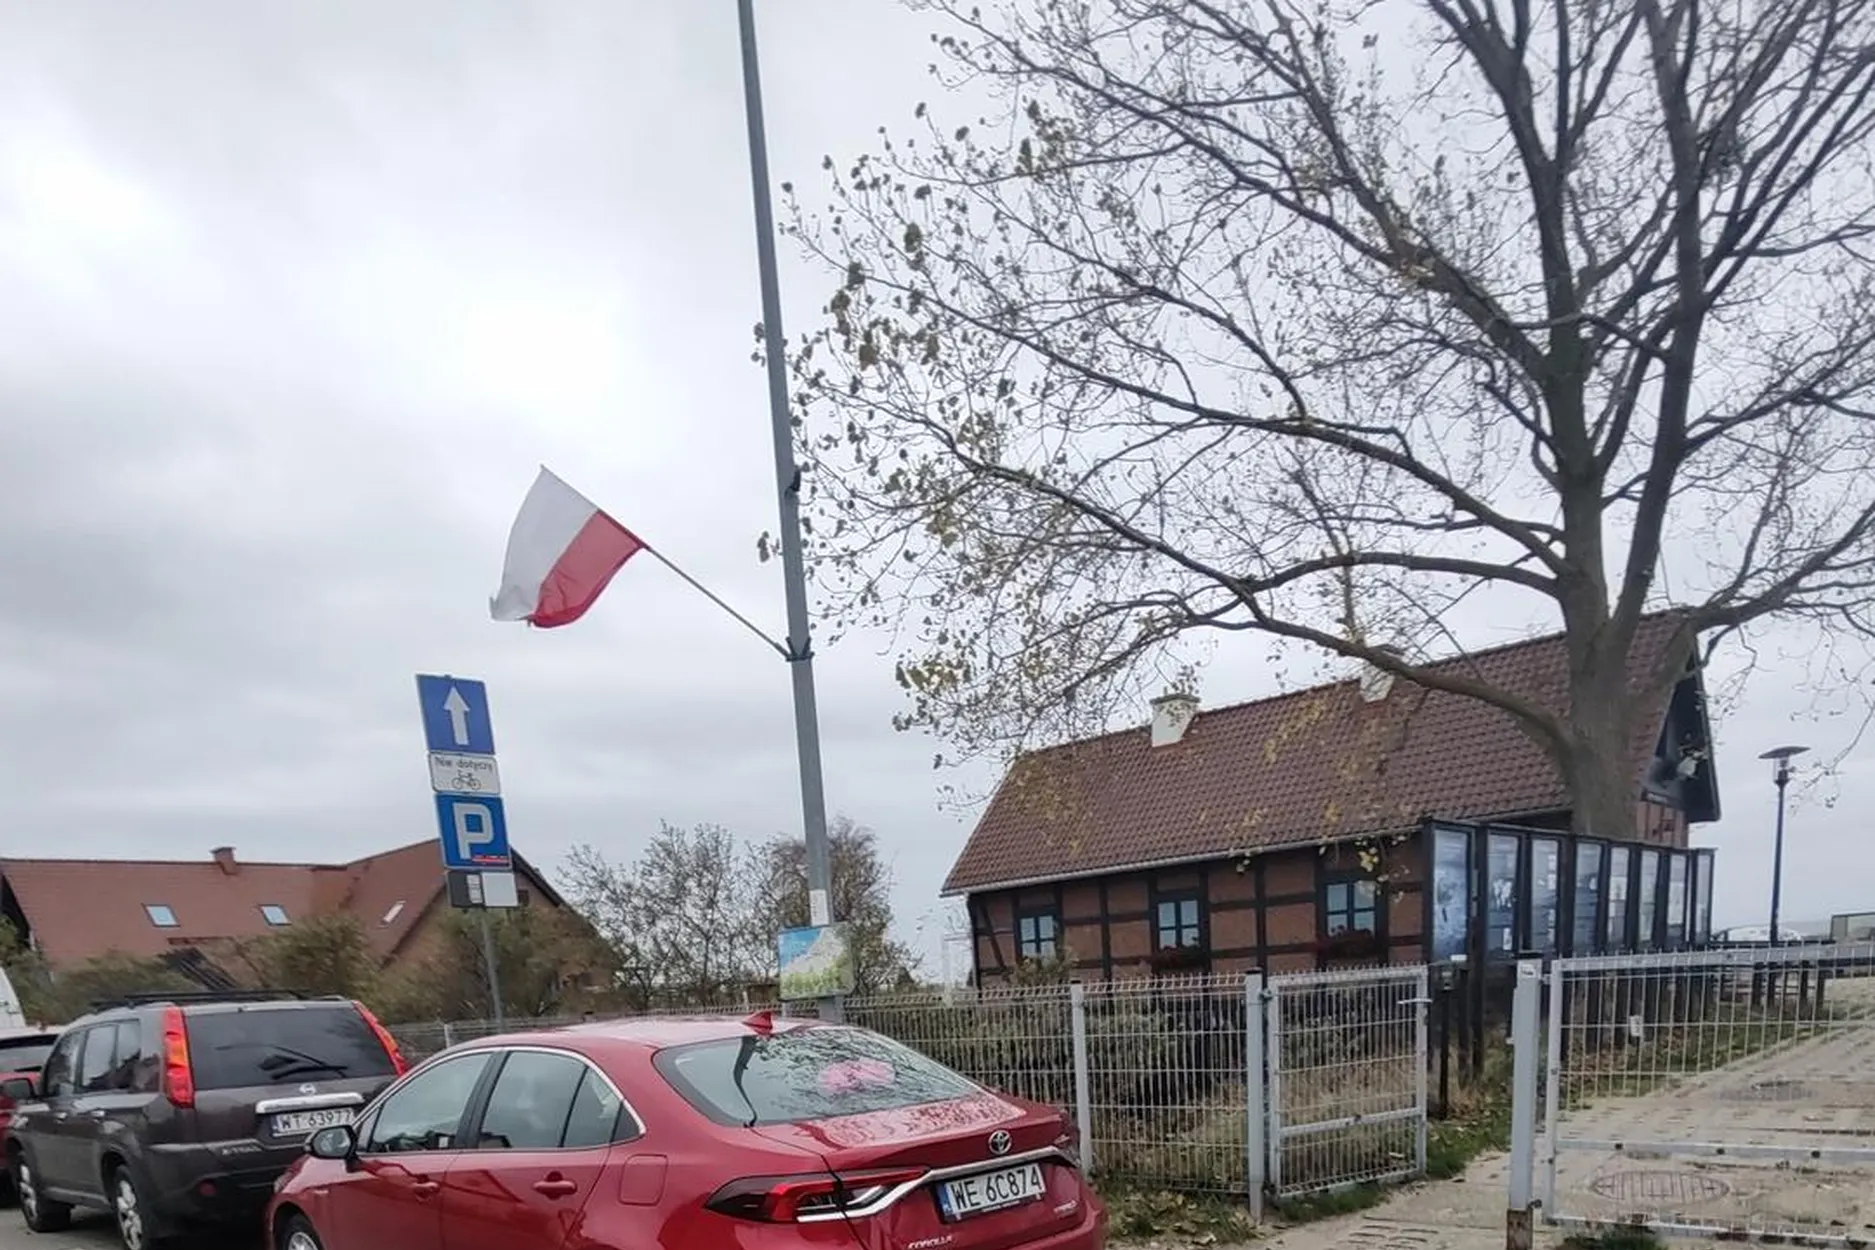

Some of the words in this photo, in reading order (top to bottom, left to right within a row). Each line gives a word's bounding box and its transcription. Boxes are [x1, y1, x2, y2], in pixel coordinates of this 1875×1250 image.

[452, 803, 494, 860] P
[280, 1113, 303, 1129] WT
[950, 1179, 981, 1210] WE
[985, 1167, 1042, 1202] 6C874
